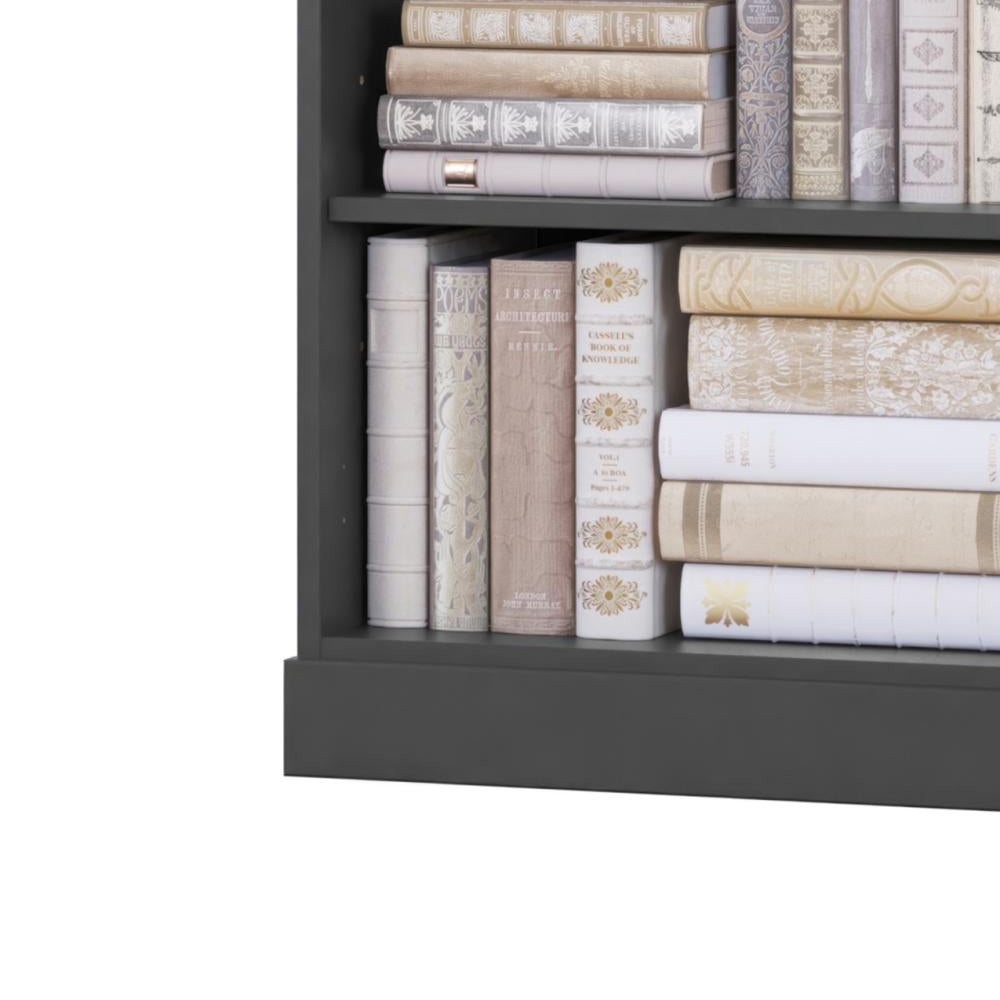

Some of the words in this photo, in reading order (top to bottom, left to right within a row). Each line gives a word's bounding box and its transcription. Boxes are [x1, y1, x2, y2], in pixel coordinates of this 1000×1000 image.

[504, 287, 561, 299] INSECT
[590, 343, 617, 352] BOOK
[582, 354, 641, 365] KNOWLEDGE
